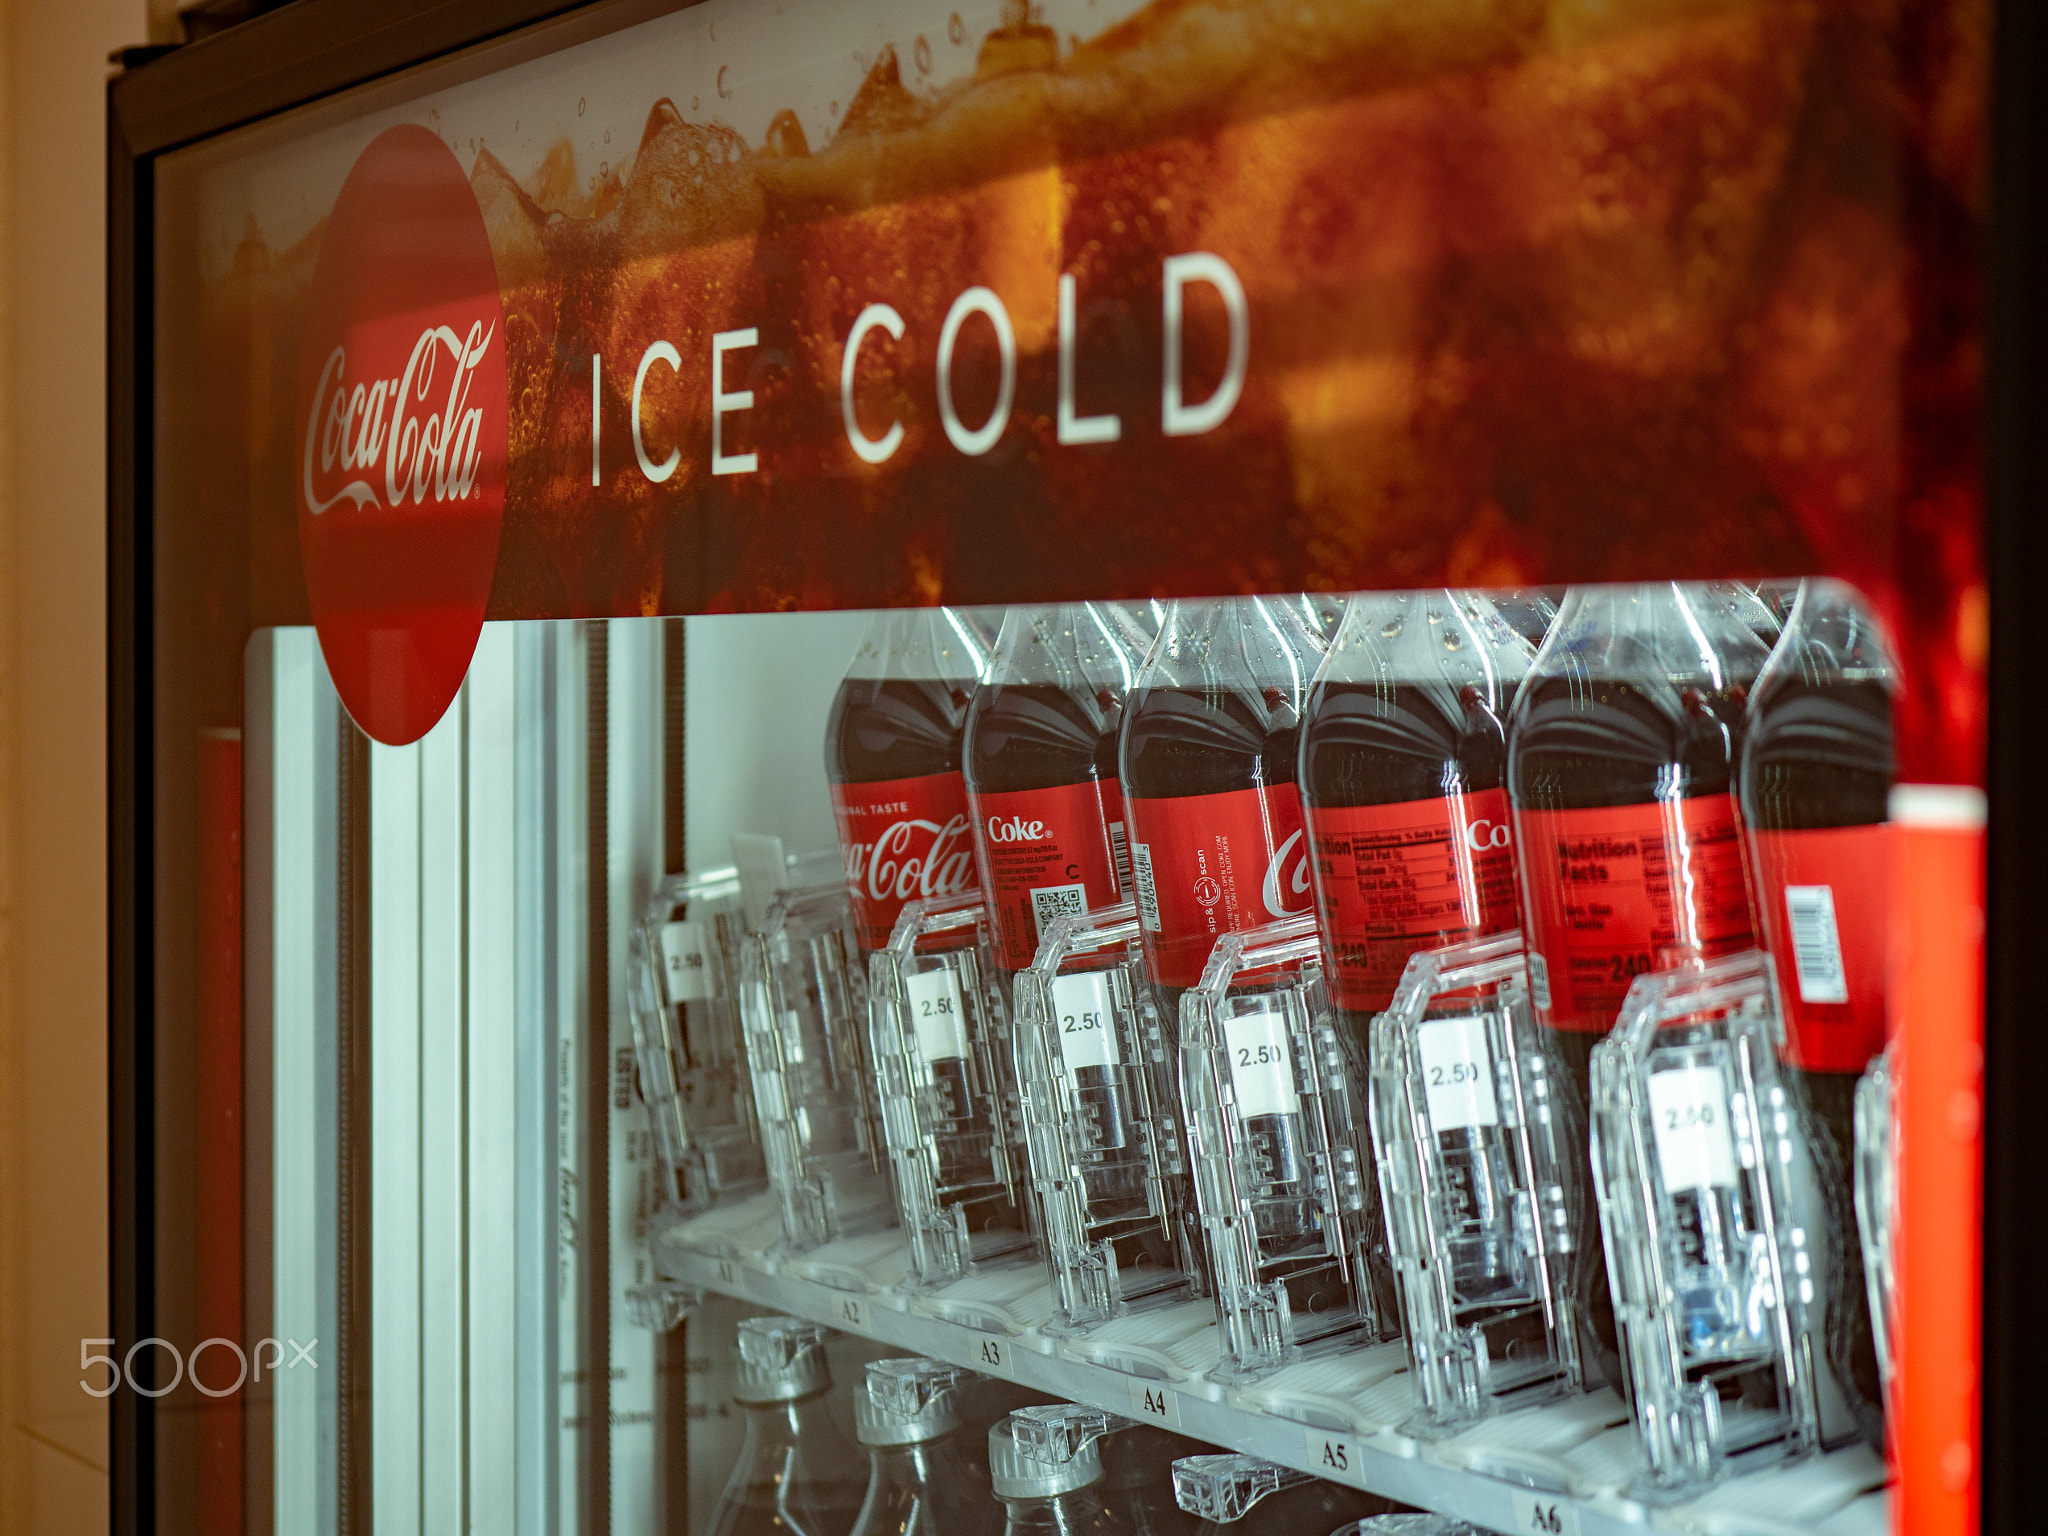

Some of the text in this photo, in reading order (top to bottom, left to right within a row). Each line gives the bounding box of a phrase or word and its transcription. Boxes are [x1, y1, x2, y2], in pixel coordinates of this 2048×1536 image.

[592, 251, 1250, 487] ICE COLD
[303, 316, 496, 515] Coca-Cola
[869, 801, 908, 815] TASTE
[989, 816, 1044, 844] Coke
[1557, 836, 1637, 859] Nutrition
[1560, 862, 1608, 881] Facts
[1197, 849, 1216, 934] sip & scan
[669, 953, 702, 972] 2.50
[1340, 943, 1368, 968] 240
[1610, 953, 1650, 982] 240
[1237, 1045, 1282, 1067] 2.50
[1430, 1061, 1478, 1086] 2.50
[841, 1300, 860, 1325] A2
[981, 1339, 1000, 1366] A3
[1143, 1387, 1166, 1416] A4
[1322, 1440, 1348, 1471] A5
[1532, 1502, 1562, 1535] A6
